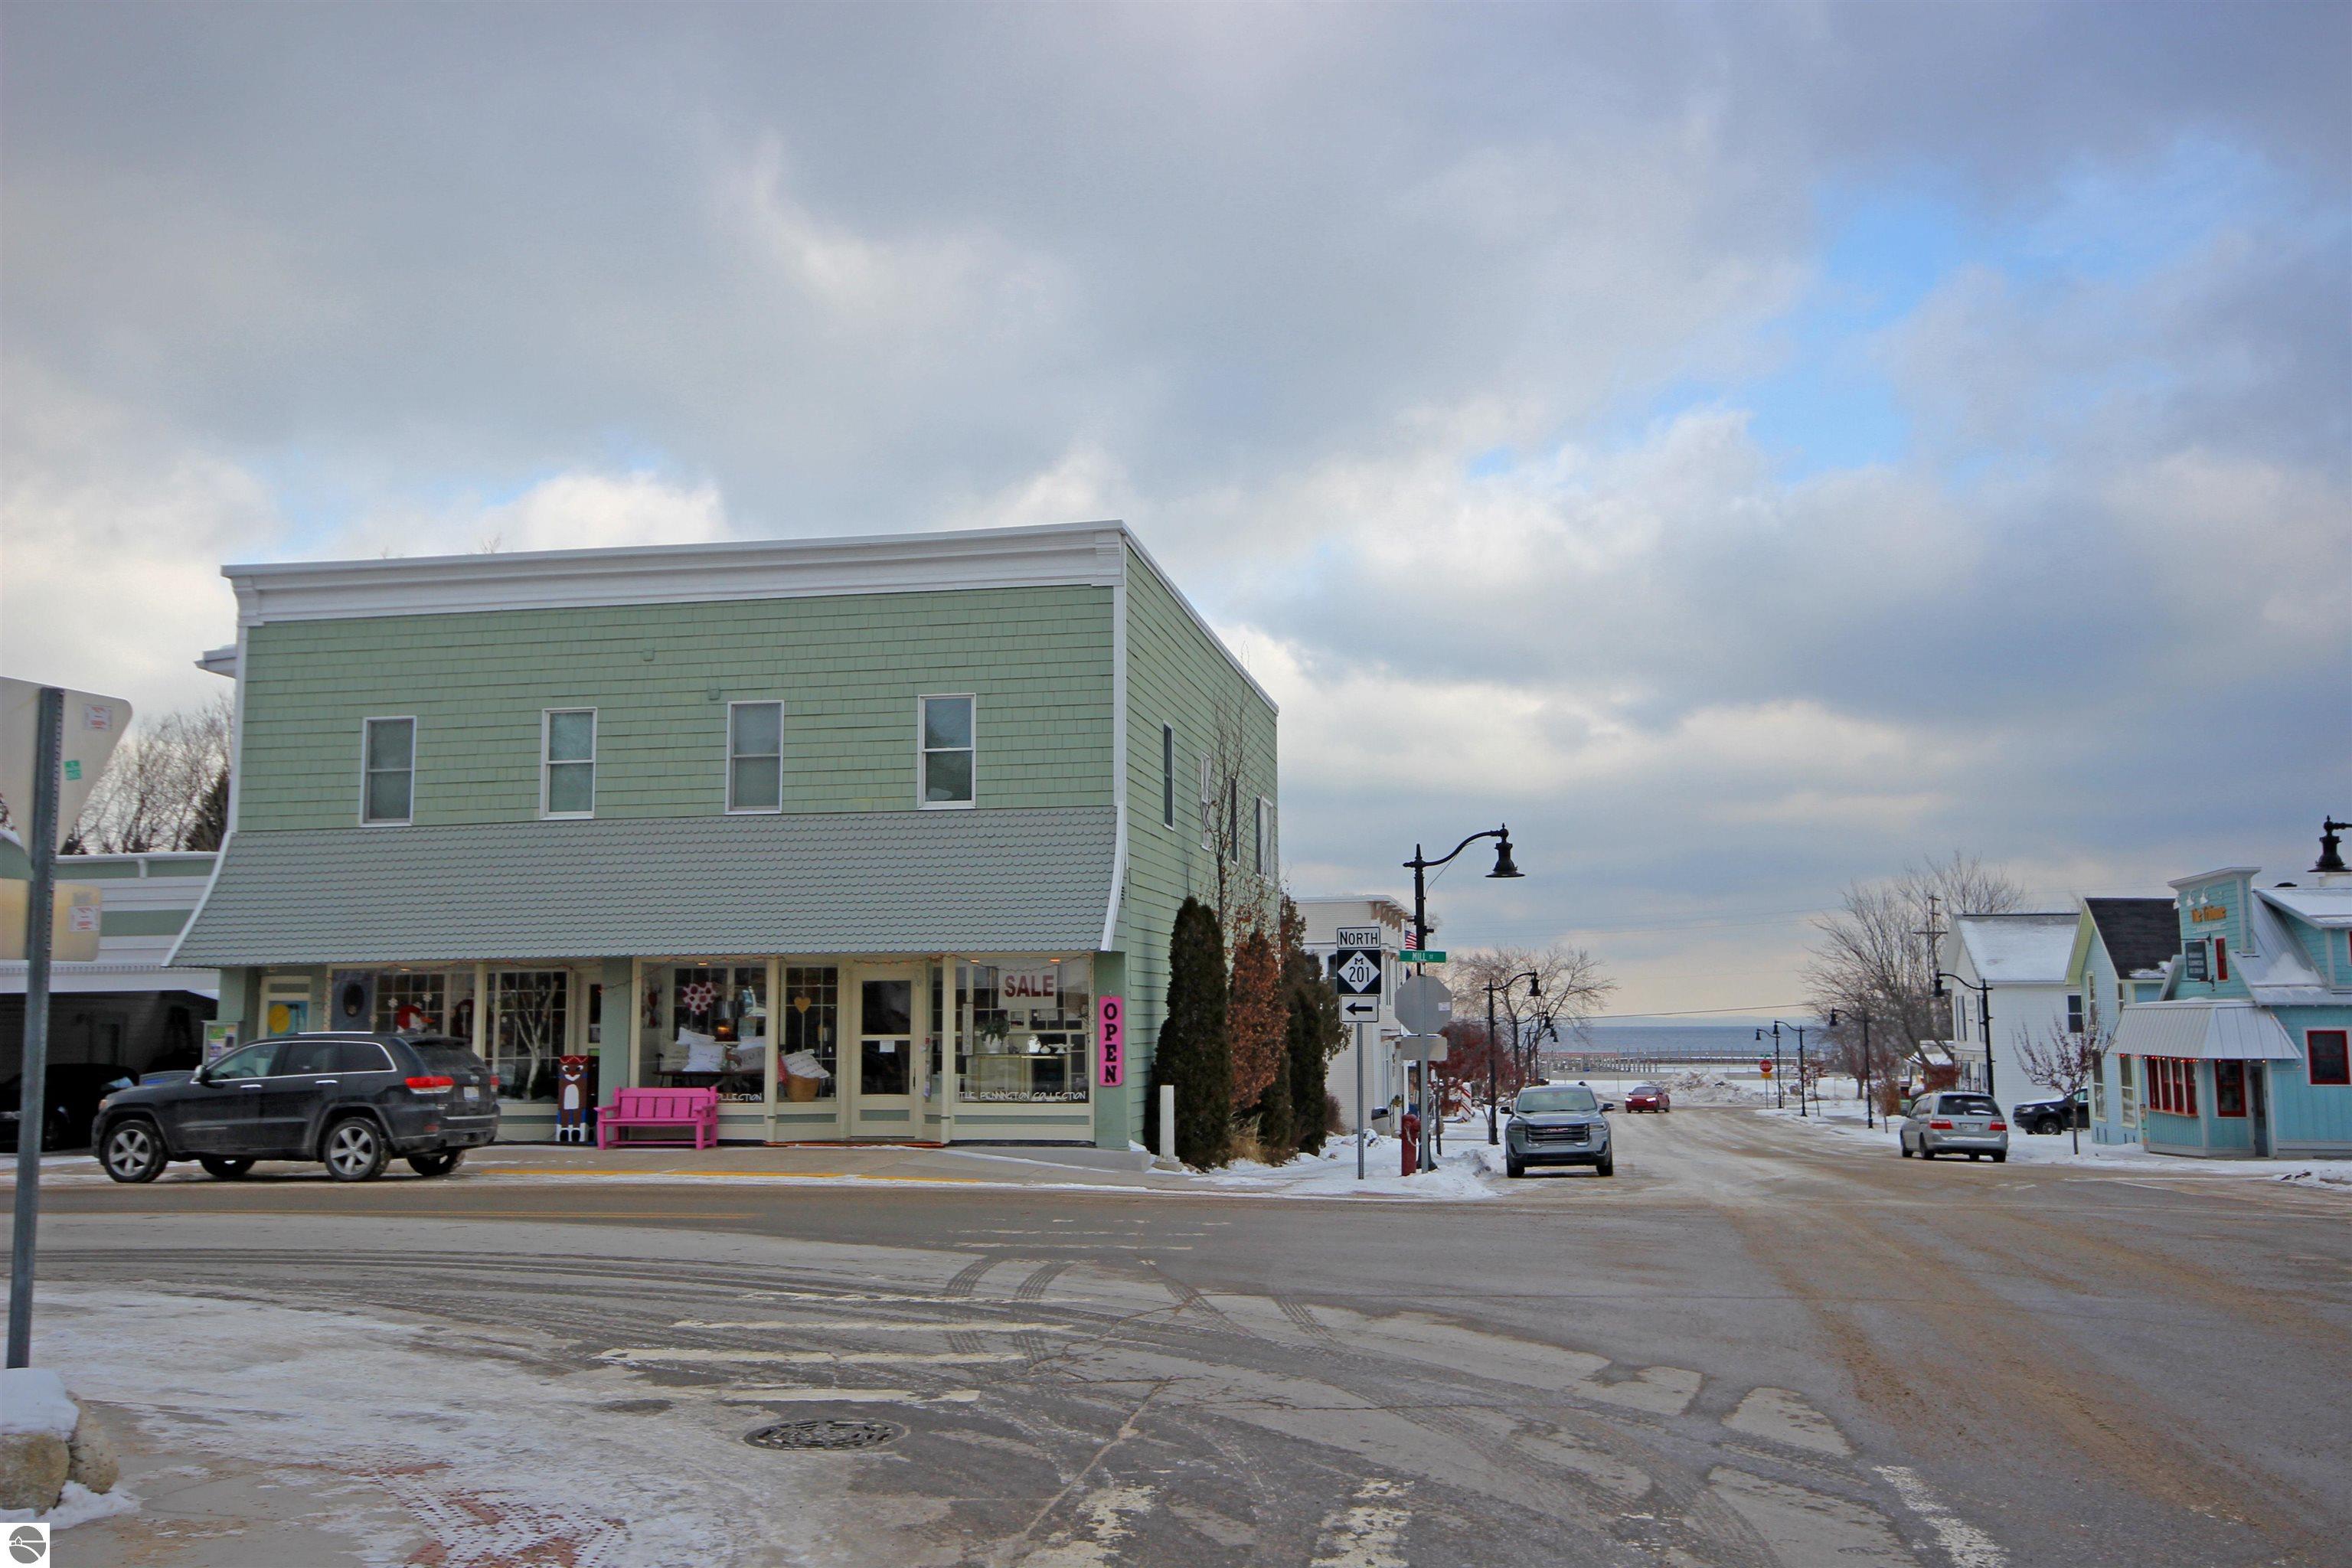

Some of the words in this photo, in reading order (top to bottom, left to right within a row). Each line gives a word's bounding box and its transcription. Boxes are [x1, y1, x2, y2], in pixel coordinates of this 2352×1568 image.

[1340, 931, 1378, 945] NORTH
[1412, 952, 1427, 962] MILL
[1349, 966, 1370, 982] 201
[1004, 975, 1054, 998] SALE
[1104, 1002, 1118, 1083] OPEN
[717, 1093, 762, 1102] OLLECTION
[1034, 1091, 1086, 1101] COLLECTION
